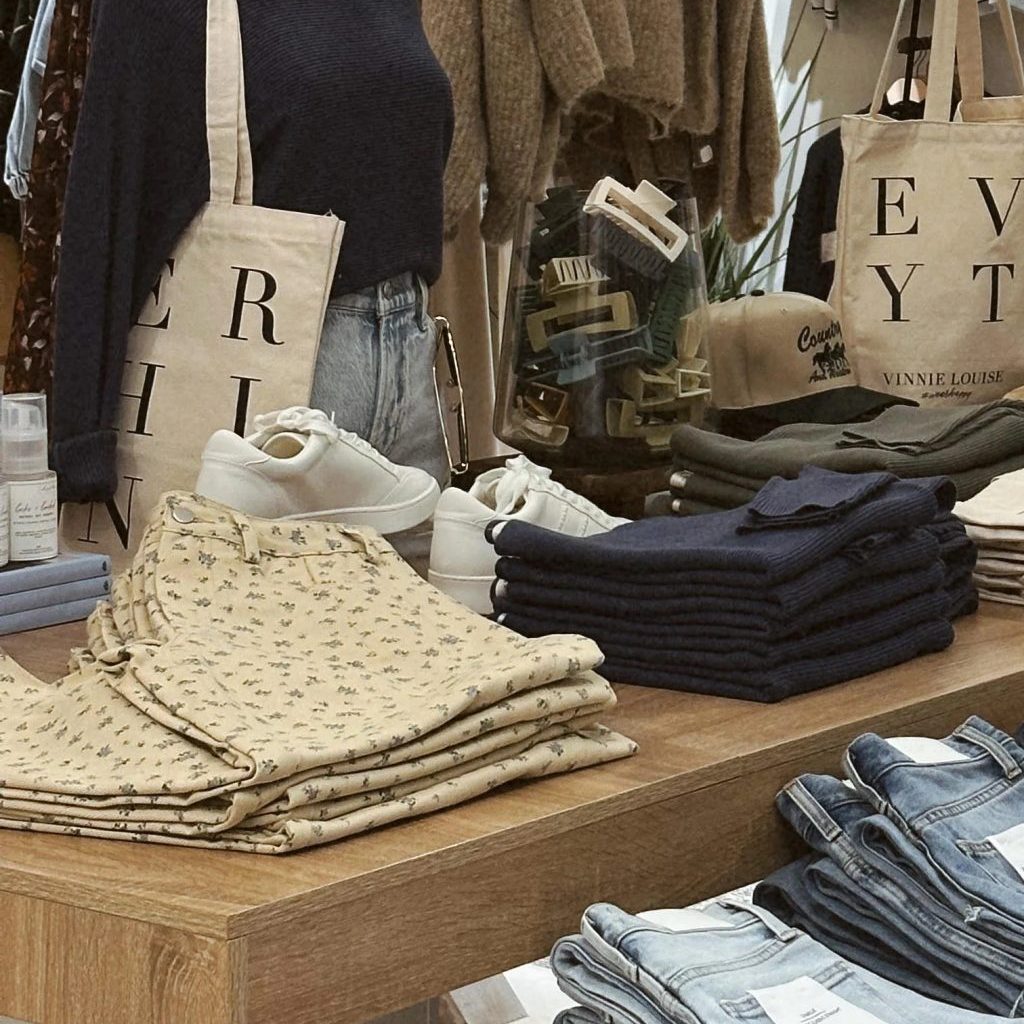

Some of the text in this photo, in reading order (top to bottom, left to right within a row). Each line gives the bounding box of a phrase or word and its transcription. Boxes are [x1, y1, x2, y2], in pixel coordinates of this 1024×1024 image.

[869, 177, 919, 236] E
[220, 266, 286, 347] R
[866, 263, 925, 323] Y
[972, 263, 1015, 323] T
[883, 370, 1005, 386] VINNIE LOUISE
